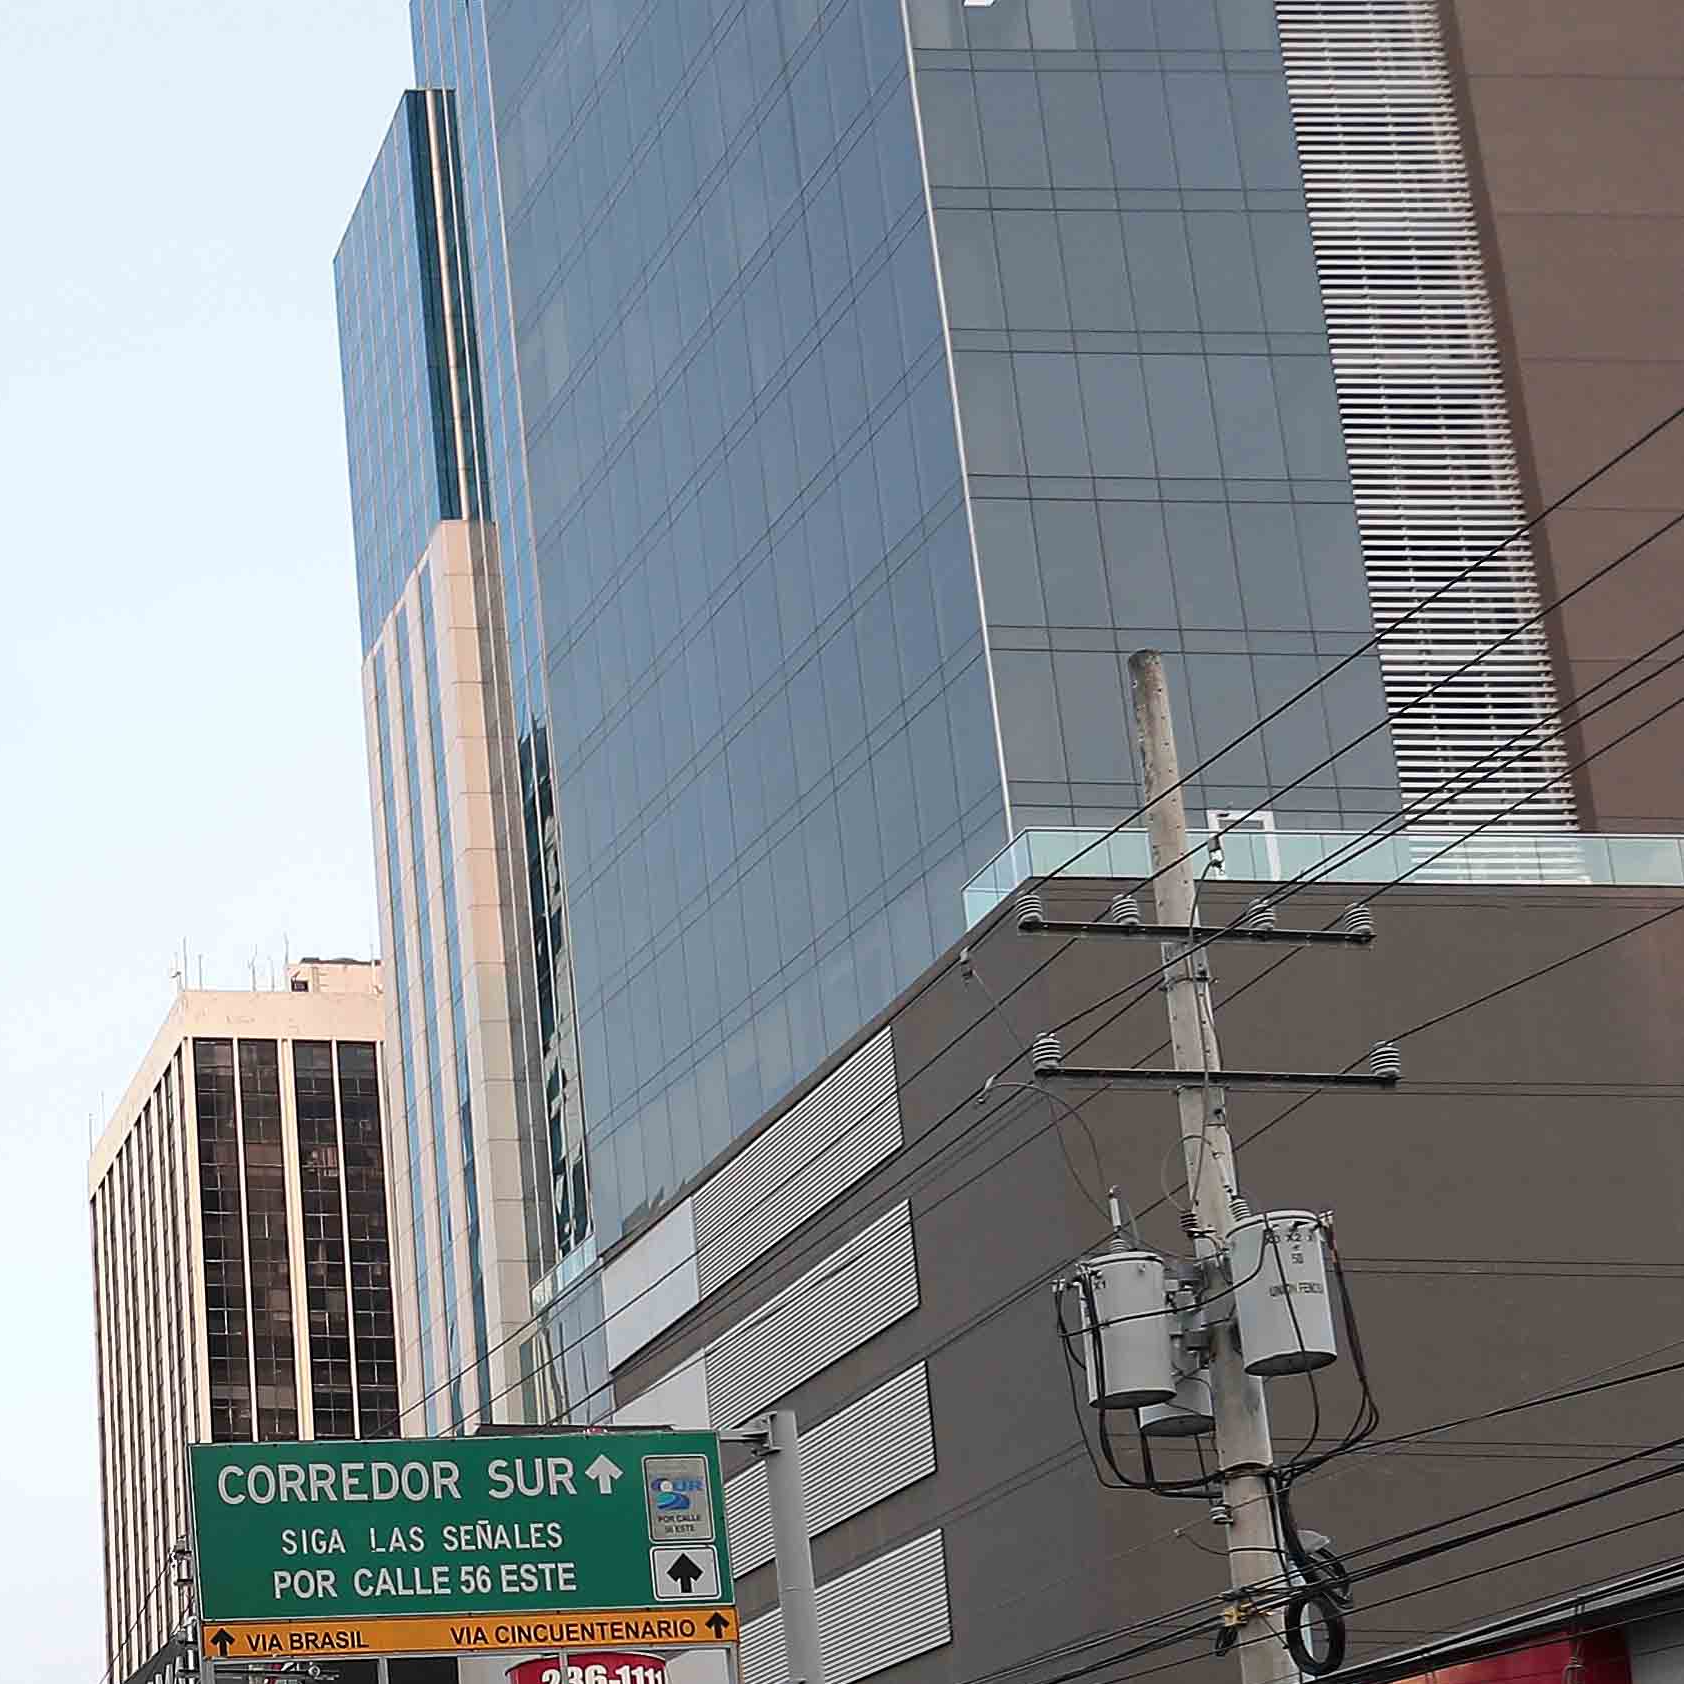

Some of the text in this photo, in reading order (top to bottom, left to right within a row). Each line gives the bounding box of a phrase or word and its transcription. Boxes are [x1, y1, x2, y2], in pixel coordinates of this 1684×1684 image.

[217, 1456, 578, 1504] CORREDOR SUR
[281, 1519, 563, 1556] SIGA LAS SEÑALES
[273, 1562, 578, 1599] POR CALLE 56 ESTE
[246, 1618, 696, 1652] VIA BRASIL VIA CINCUENTENARIO
